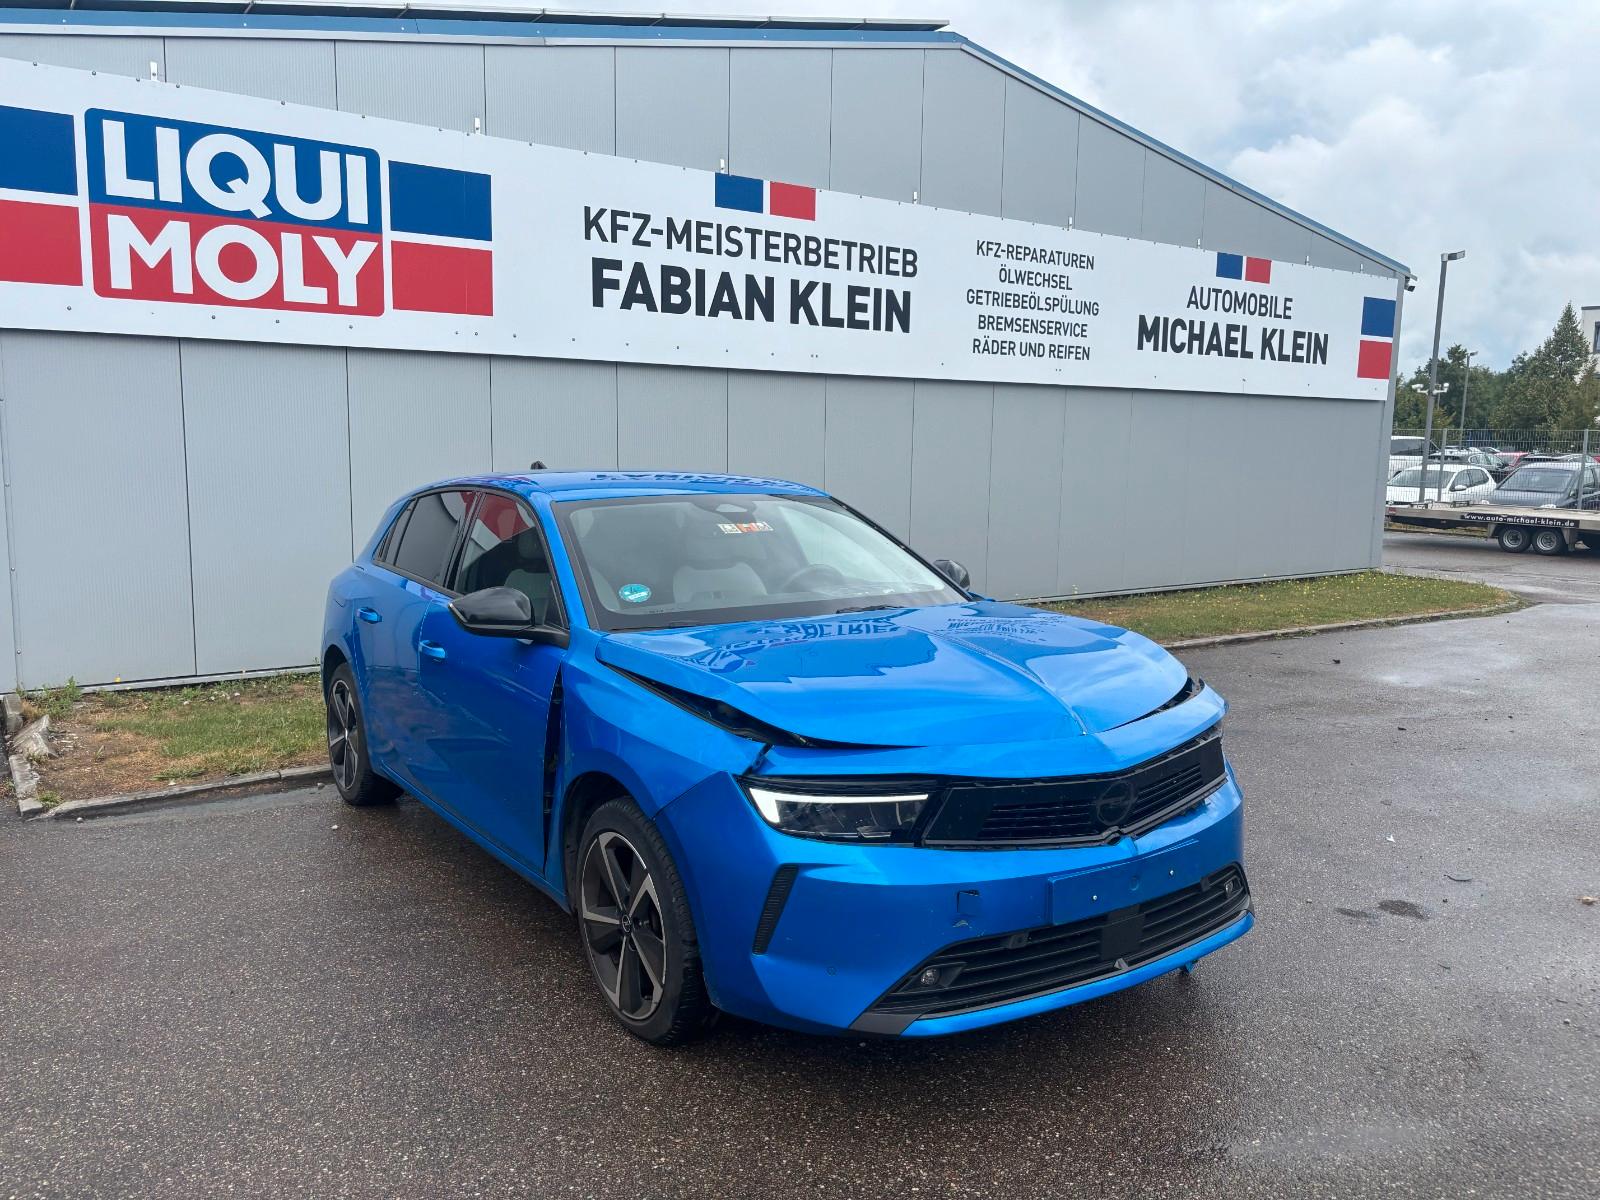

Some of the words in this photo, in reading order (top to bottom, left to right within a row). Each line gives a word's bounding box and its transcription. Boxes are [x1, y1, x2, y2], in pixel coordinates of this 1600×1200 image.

[103, 119, 369, 224] LIQUI
[584, 206, 918, 278] KFZ-MEISTERBETRIEB
[976, 239, 1095, 270] KFZ-REPARATUREN
[107, 214, 378, 307] MOLY
[999, 264, 1072, 290] ÖLWECHSEL
[592, 257, 775, 323] FABIAN
[790, 278, 911, 333] KLEIN
[966, 289, 1100, 316] GETRIEBEÖLSPÜLUNG
[1187, 285, 1293, 320] AUTOMOBILE
[978, 314, 1088, 338] BREMSENSERVICE
[1137, 314, 1254, 360] MICHAEL
[1260, 327, 1329, 365] KLEIN
[972, 335, 1016, 356] RÄDER
[1019, 341, 1045, 358] UND
[1048, 343, 1091, 361] REIFEN
